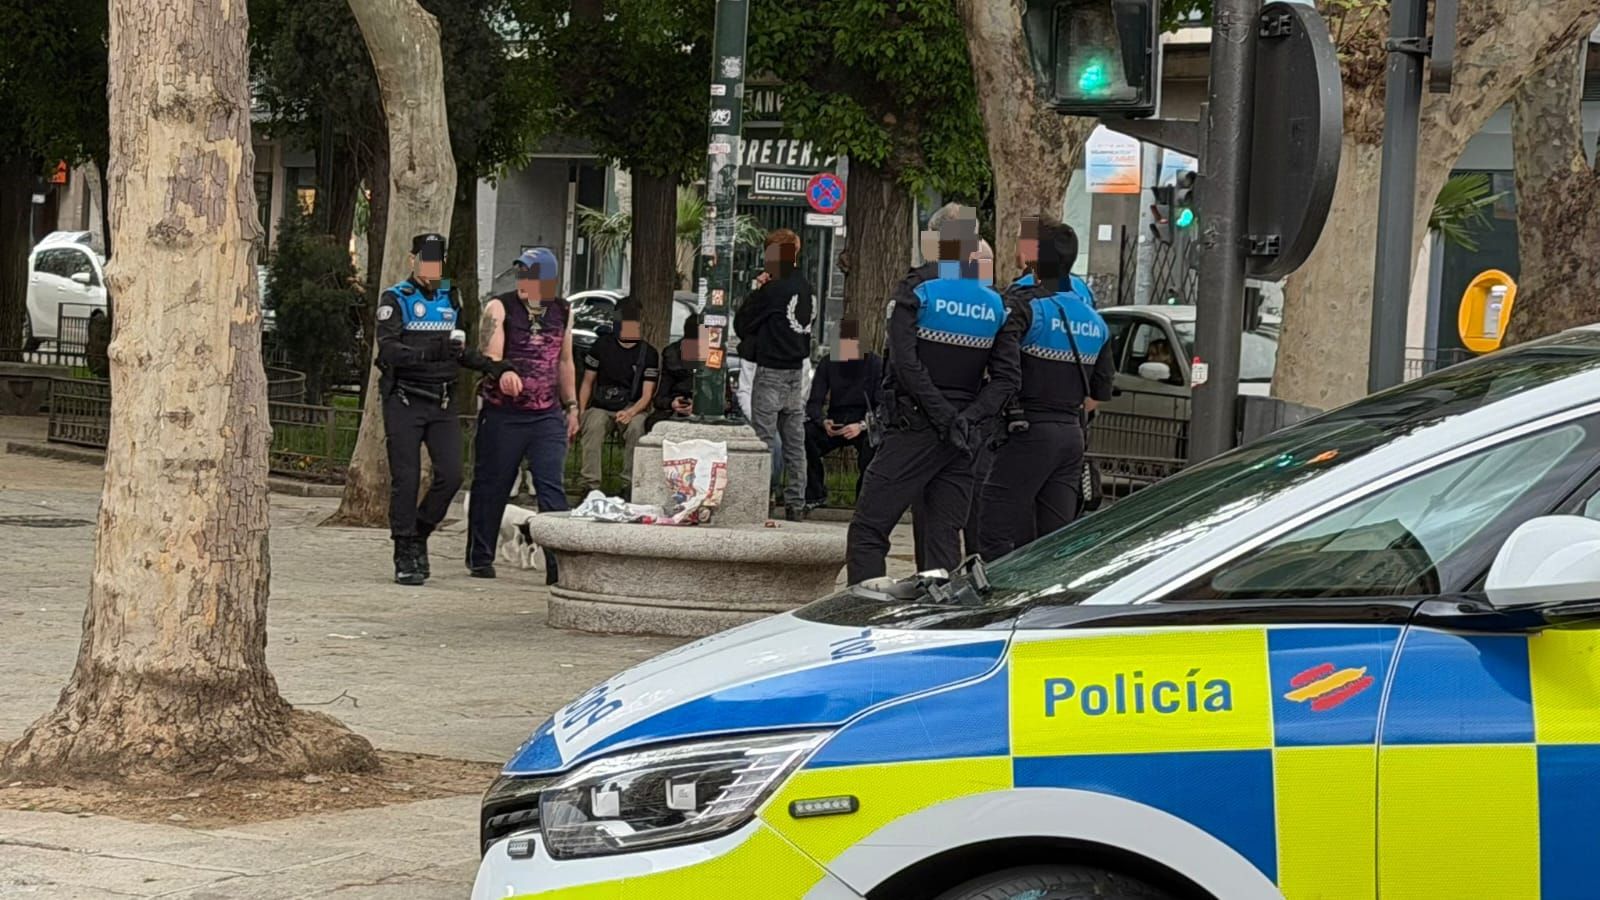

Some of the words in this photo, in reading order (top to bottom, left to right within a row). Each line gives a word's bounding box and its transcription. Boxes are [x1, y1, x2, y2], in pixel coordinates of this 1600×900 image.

[760, 176, 810, 191] FERRETERI
[935, 299, 995, 322] POLICÍA
[1044, 668, 1232, 717] Policía
